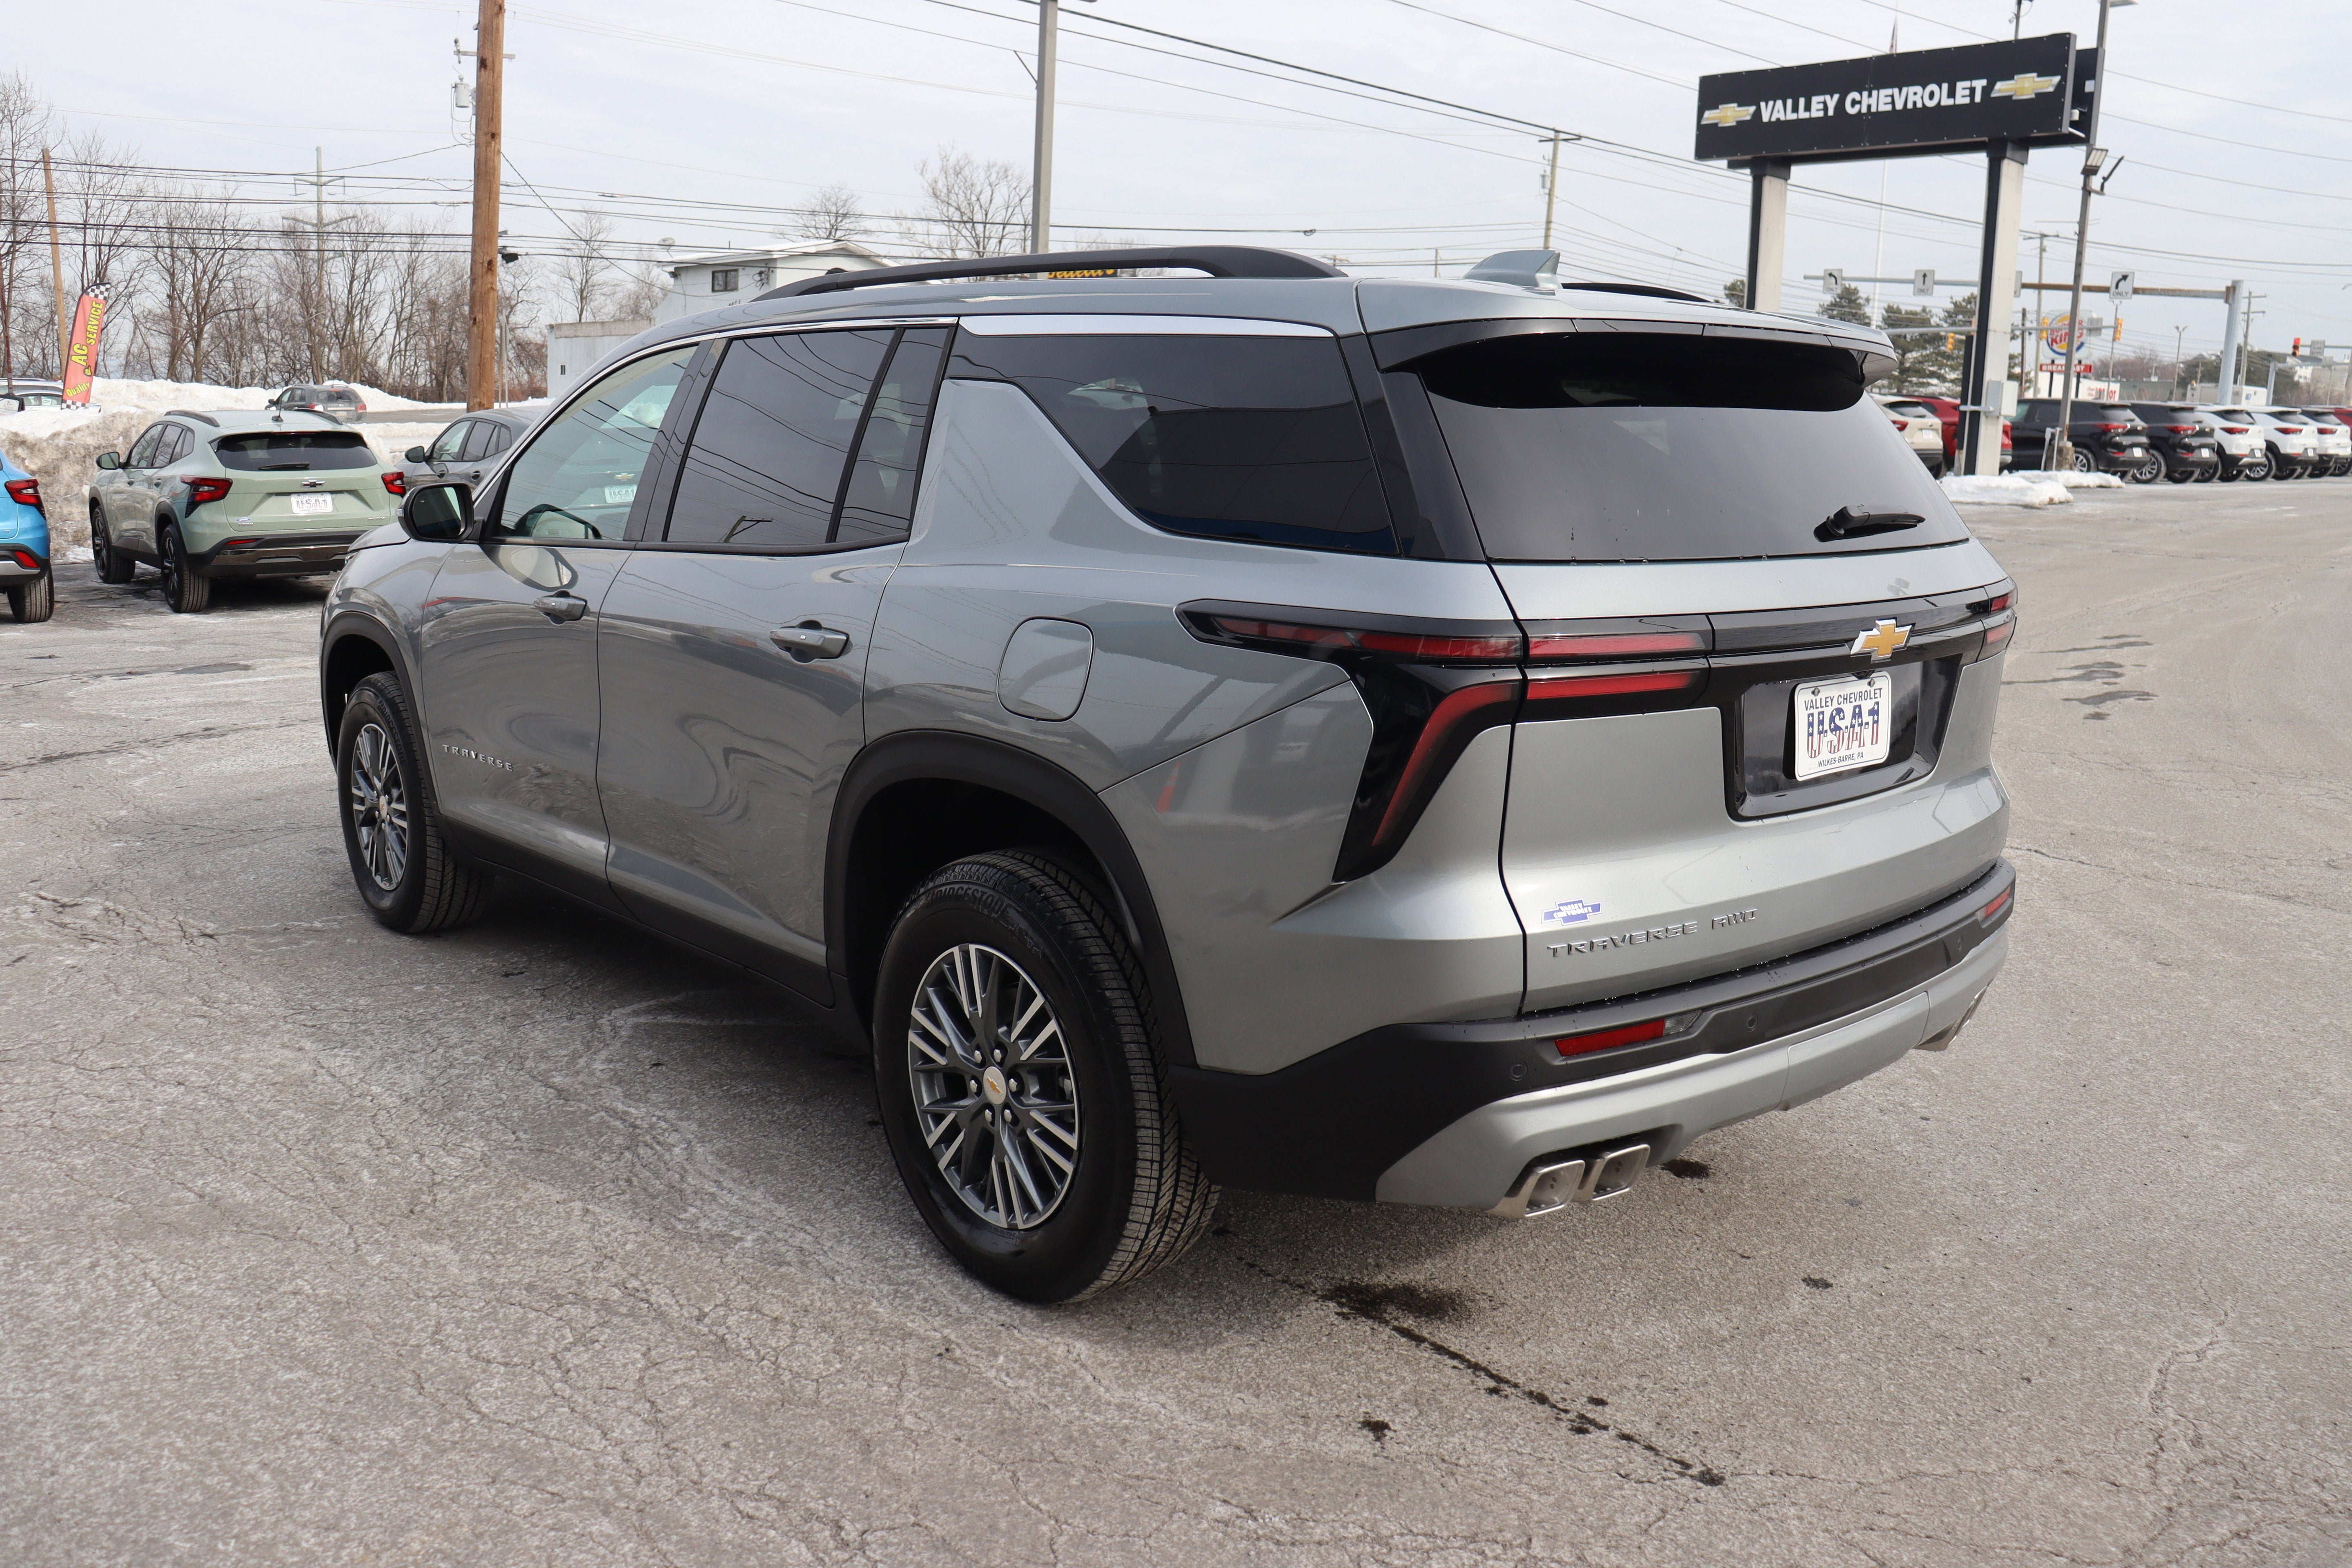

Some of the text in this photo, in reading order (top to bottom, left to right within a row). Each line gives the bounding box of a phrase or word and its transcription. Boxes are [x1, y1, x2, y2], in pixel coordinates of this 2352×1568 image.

[1760, 79, 1987, 122] VALLEY CHEVROLET
[71, 301, 104, 367] AC SERVICE
[66, 382, 90, 397] Quality
[1804, 687, 1882, 711] VALLEY CHEVROLET
[442, 744, 513, 771] TRAVERSE
[1818, 753, 1856, 768] WILKES-BARRE,
[1553, 906, 1592, 918] CHEVROLET
[1559, 903, 1583, 911] VALLEY
[1547, 909, 1757, 957] TRAVERSE AWD
